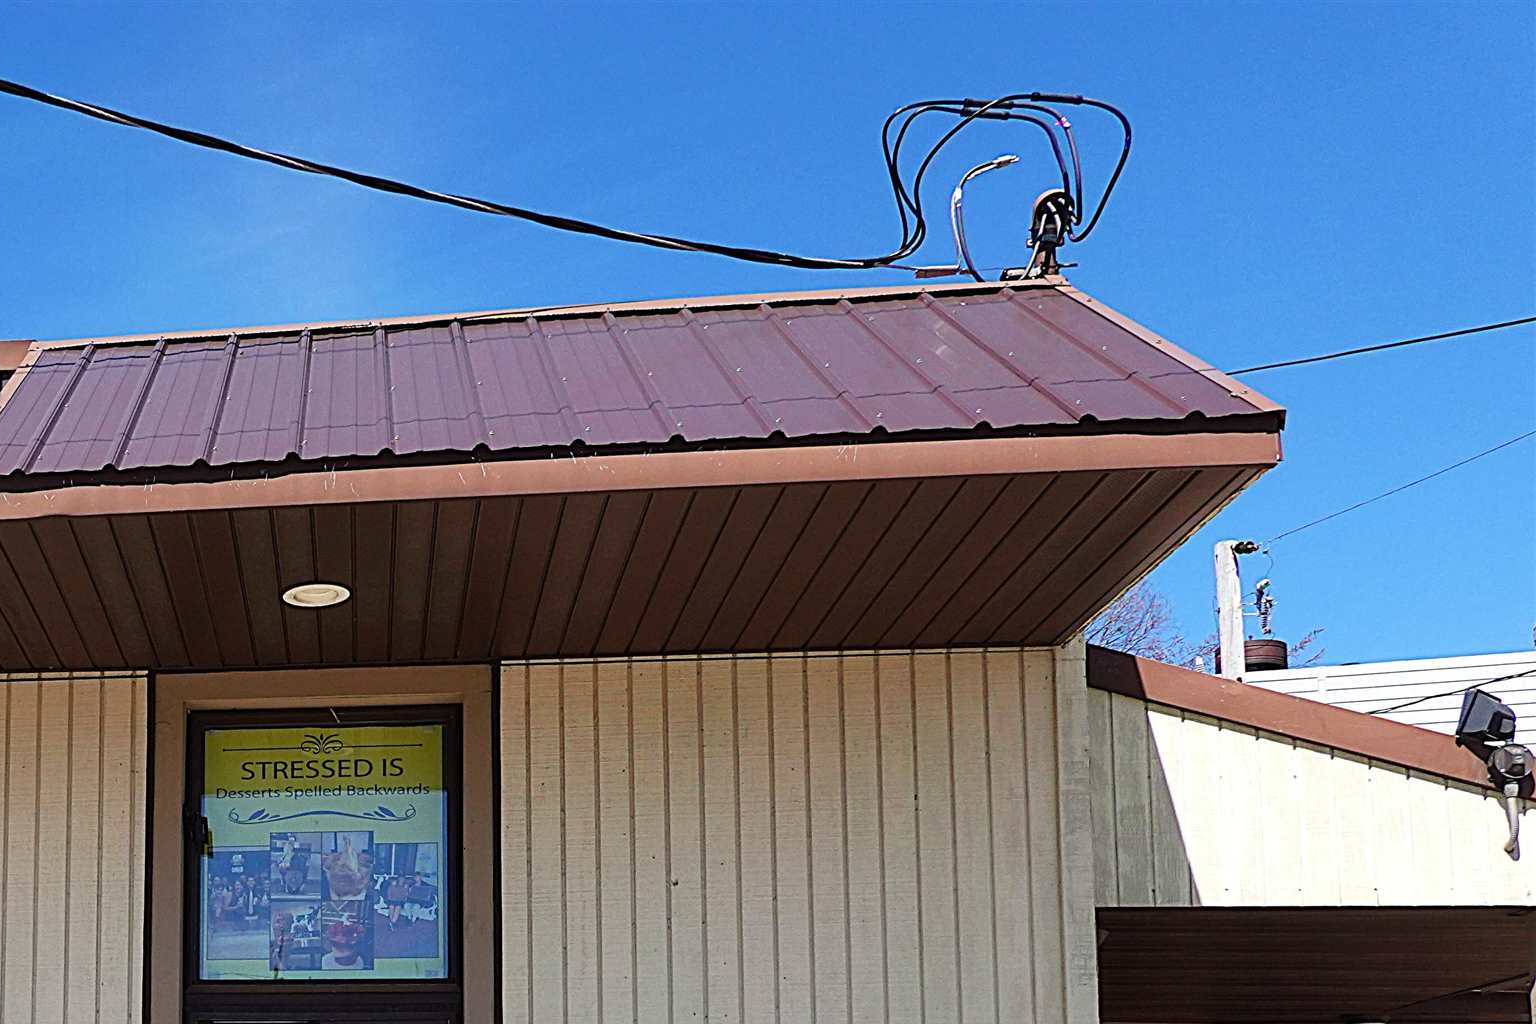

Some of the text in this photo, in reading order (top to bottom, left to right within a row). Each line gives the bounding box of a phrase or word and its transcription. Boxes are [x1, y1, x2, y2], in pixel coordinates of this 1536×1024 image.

[241, 758, 404, 780] STRESSED IS
[216, 783, 430, 800] Desserts Spelled Backwards
